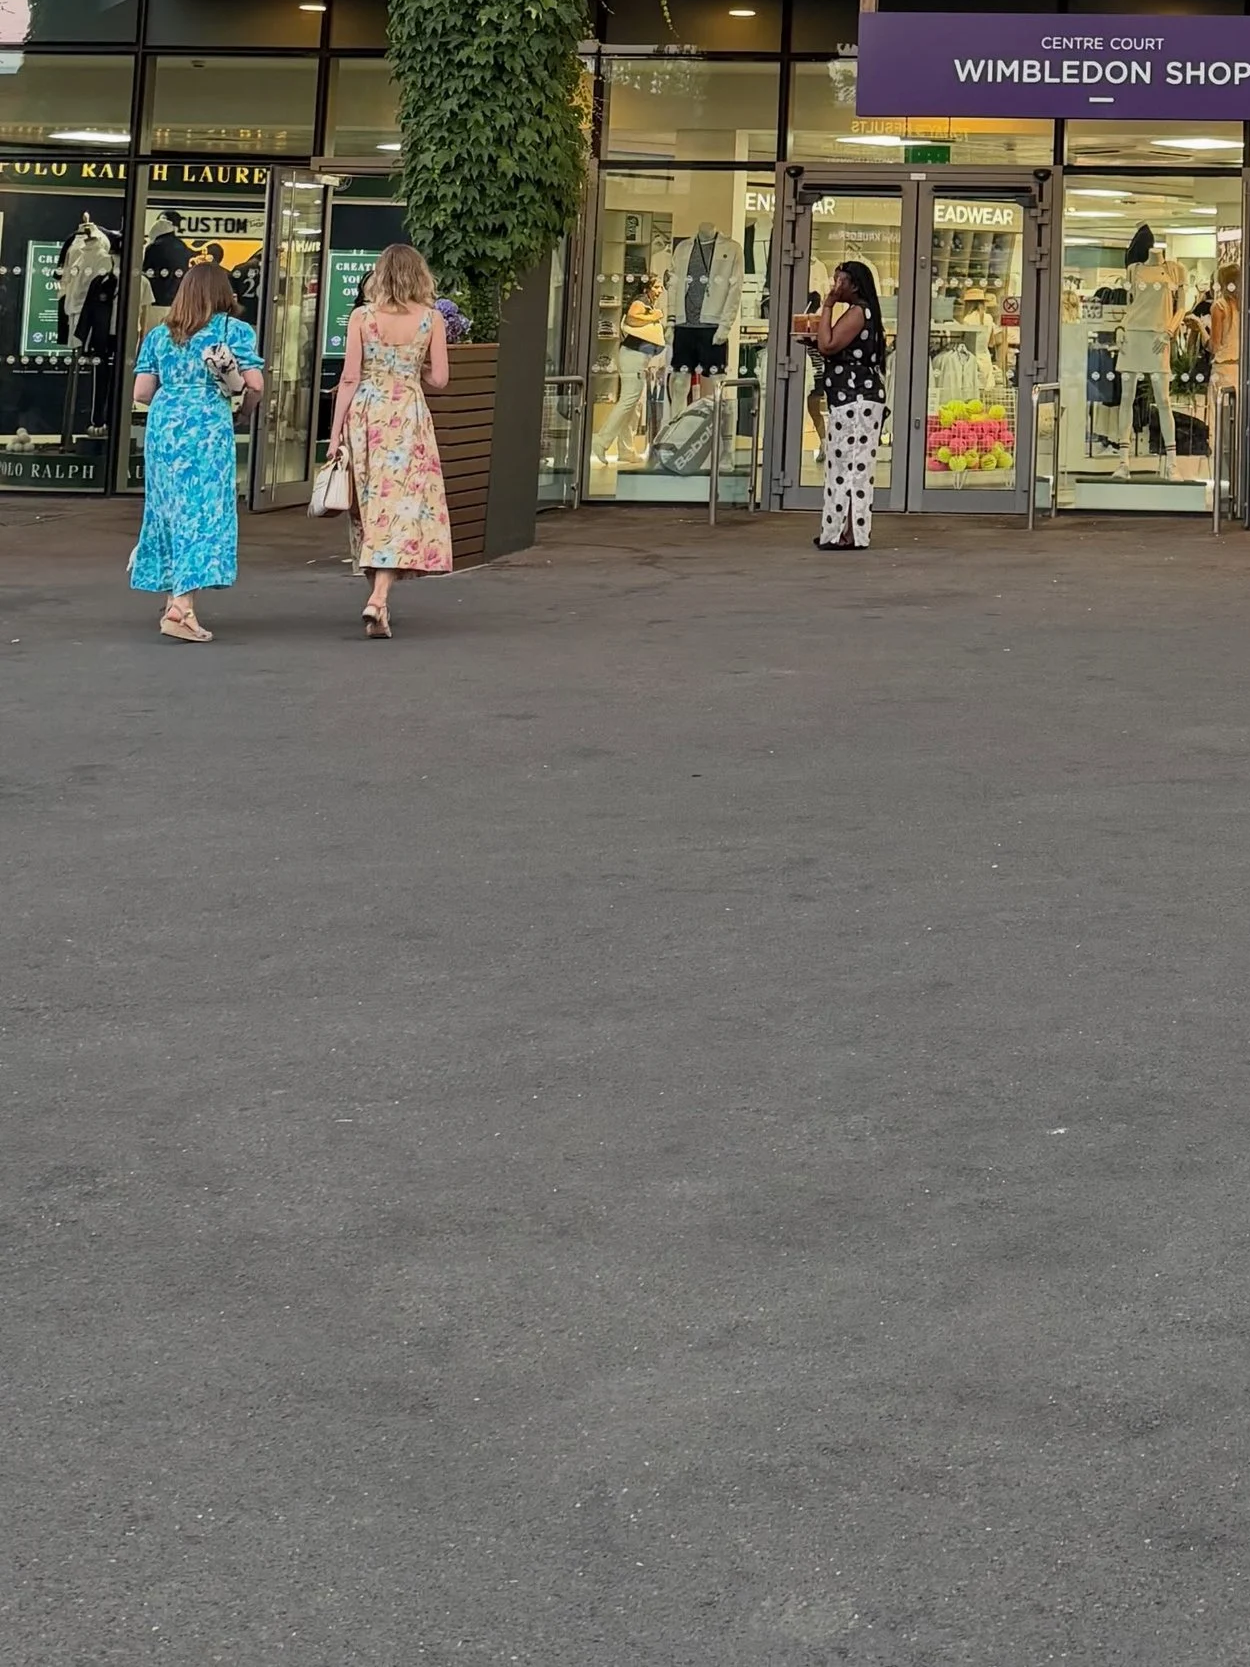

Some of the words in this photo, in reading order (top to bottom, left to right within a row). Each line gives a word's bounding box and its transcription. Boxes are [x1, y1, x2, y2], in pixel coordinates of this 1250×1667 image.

[1041, 36, 1104, 50] CENTRE
[1110, 36, 1164, 51] COURT
[954, 58, 1152, 84] WIMBLEDON
[80, 162, 169, 181] RALH
[183, 165, 268, 184] LAURE
[934, 205, 1014, 226] EADWEAR
[38, 254, 60, 264] CRE
[342, 288, 359, 296] OW
[31, 464, 95, 480] RALPH
